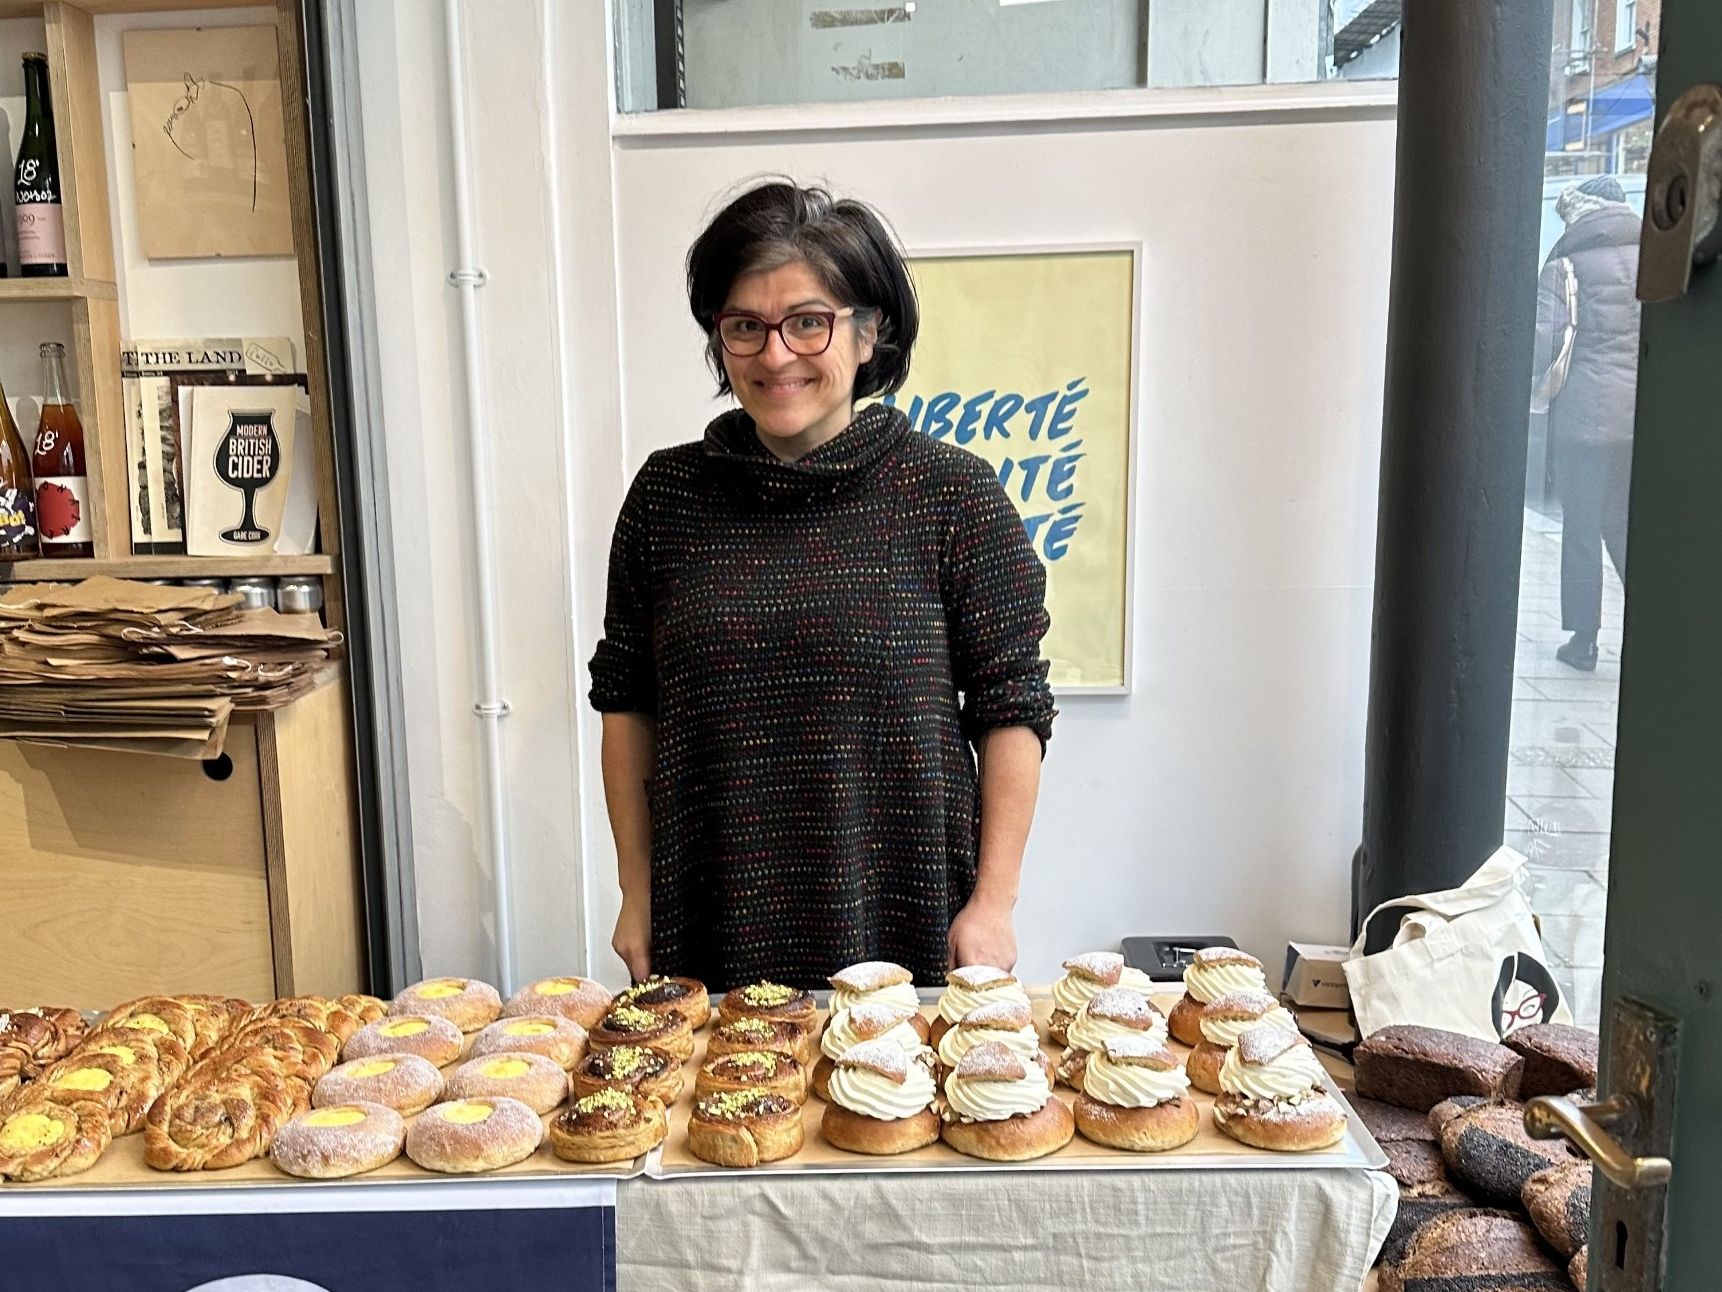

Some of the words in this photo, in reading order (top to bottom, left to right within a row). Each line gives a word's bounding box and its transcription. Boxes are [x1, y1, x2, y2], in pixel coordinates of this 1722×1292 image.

[141, 351, 181, 365] THE
[187, 350, 243, 365] LAND
[883, 376, 1089, 445] IBERTÉ
[236, 424, 268, 437] MODERN
[229, 438, 273, 456] BRITISH
[228, 455, 272, 478] CIDER
